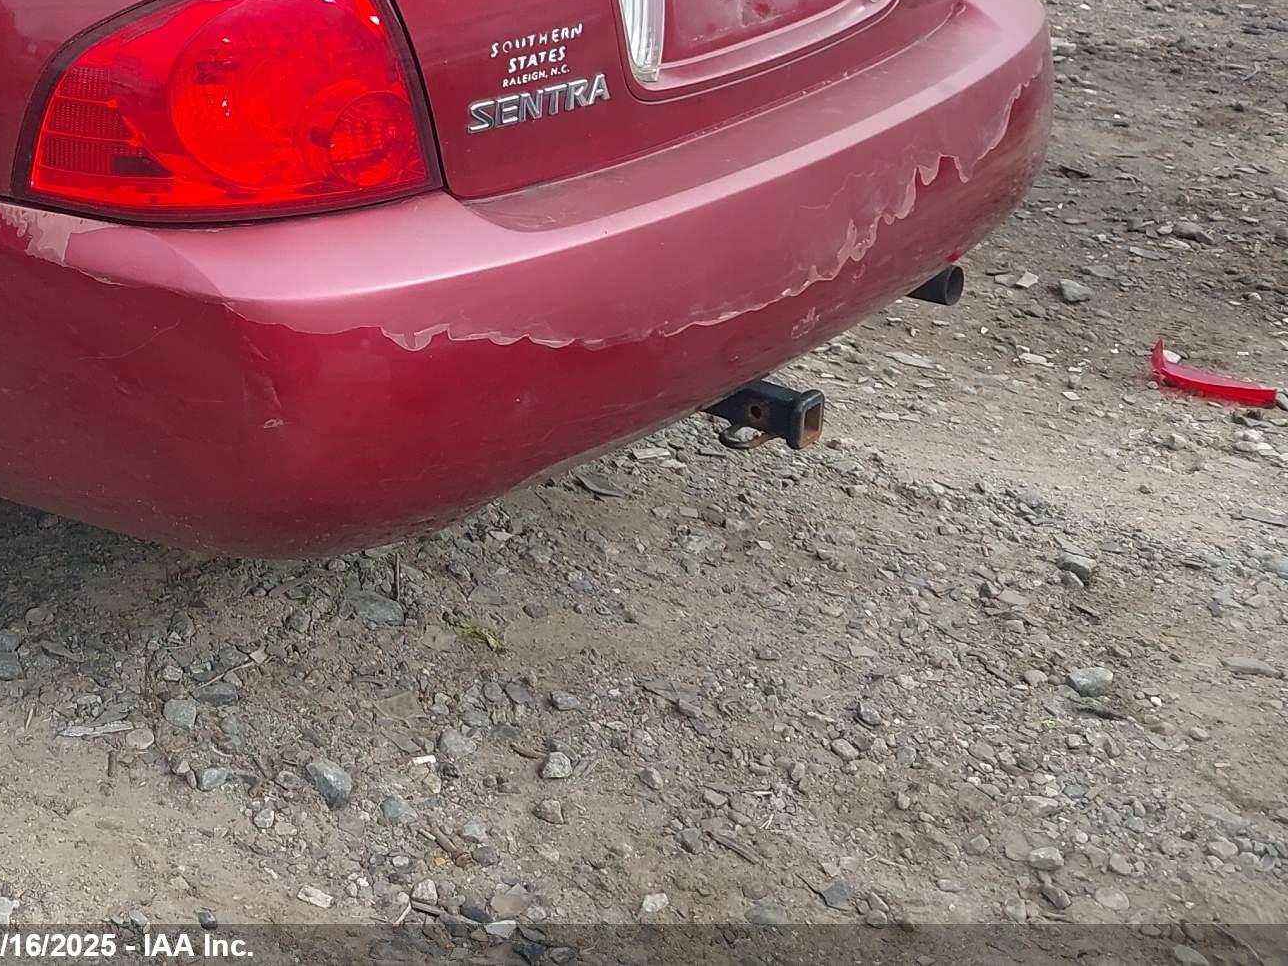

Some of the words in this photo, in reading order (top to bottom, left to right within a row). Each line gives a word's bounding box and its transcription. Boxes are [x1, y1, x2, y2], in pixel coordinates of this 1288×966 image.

[490, 23, 583, 58] SOUTHERN
[508, 46, 566, 73] STATES
[502, 70, 548, 87] RALEIGH,
[550, 65, 570, 76] N.C.
[468, 73, 610, 133] SENTRA
